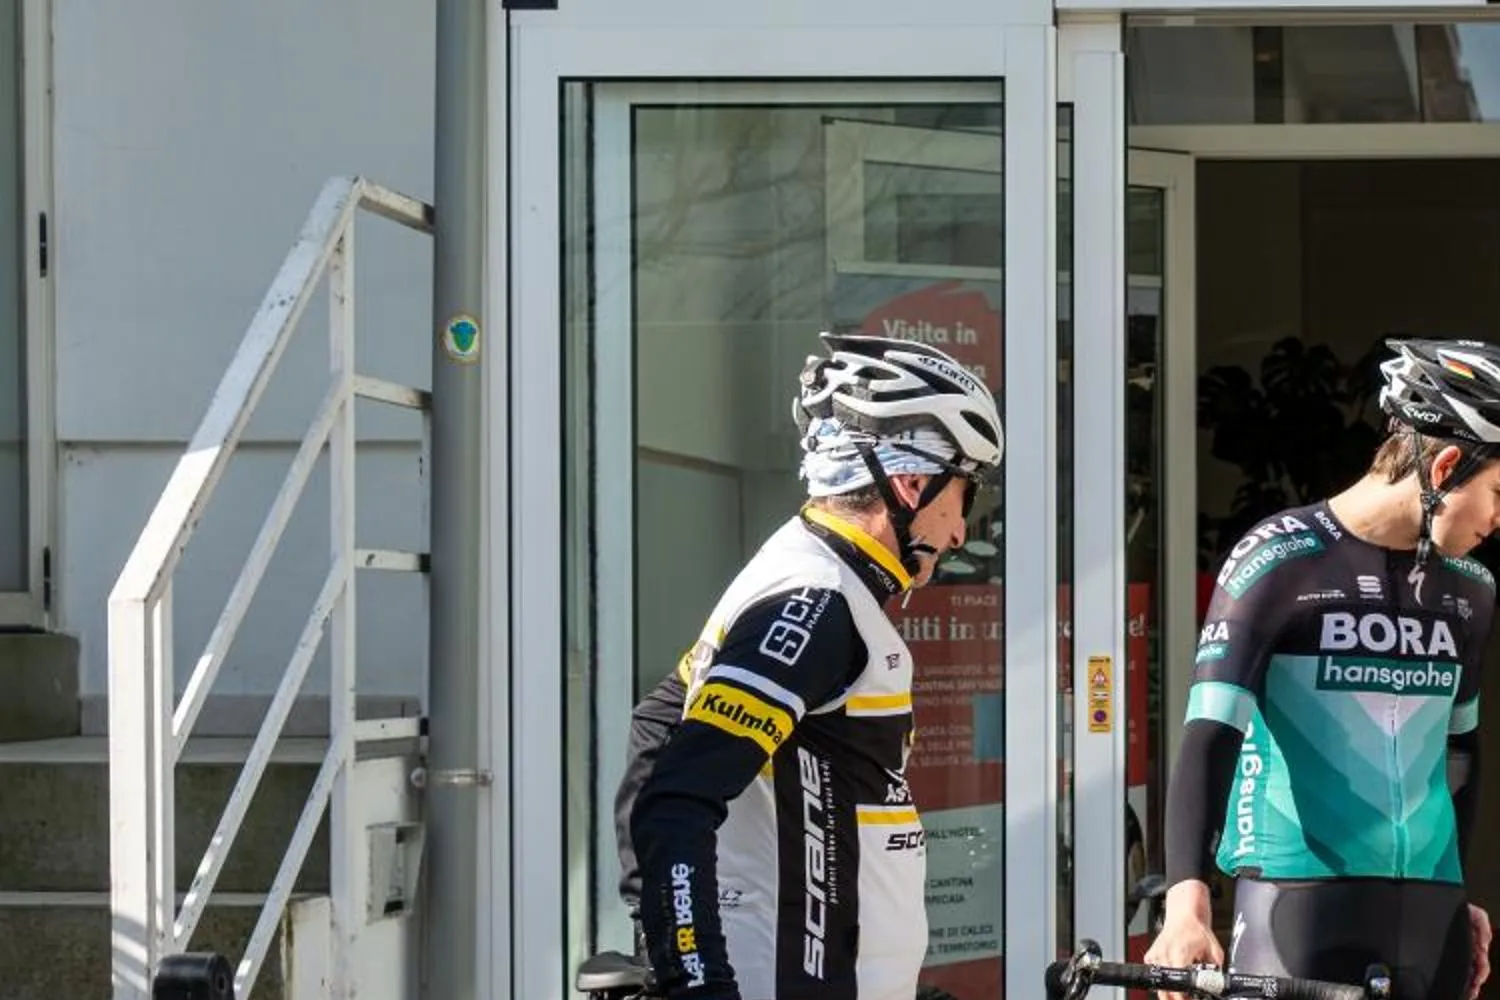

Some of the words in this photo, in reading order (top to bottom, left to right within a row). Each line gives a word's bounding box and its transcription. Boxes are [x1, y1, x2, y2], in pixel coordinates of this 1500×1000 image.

[882, 319, 949, 344] Visita
[956, 321, 978, 345] in
[1314, 510, 1342, 541] BORA
[1216, 514, 1308, 587] BORA
[1228, 534, 1317, 589] hansgrohe
[1320, 612, 1458, 658] BORA
[1323, 655, 1455, 690] hansgrohe
[701, 692, 784, 746] Kulmba
